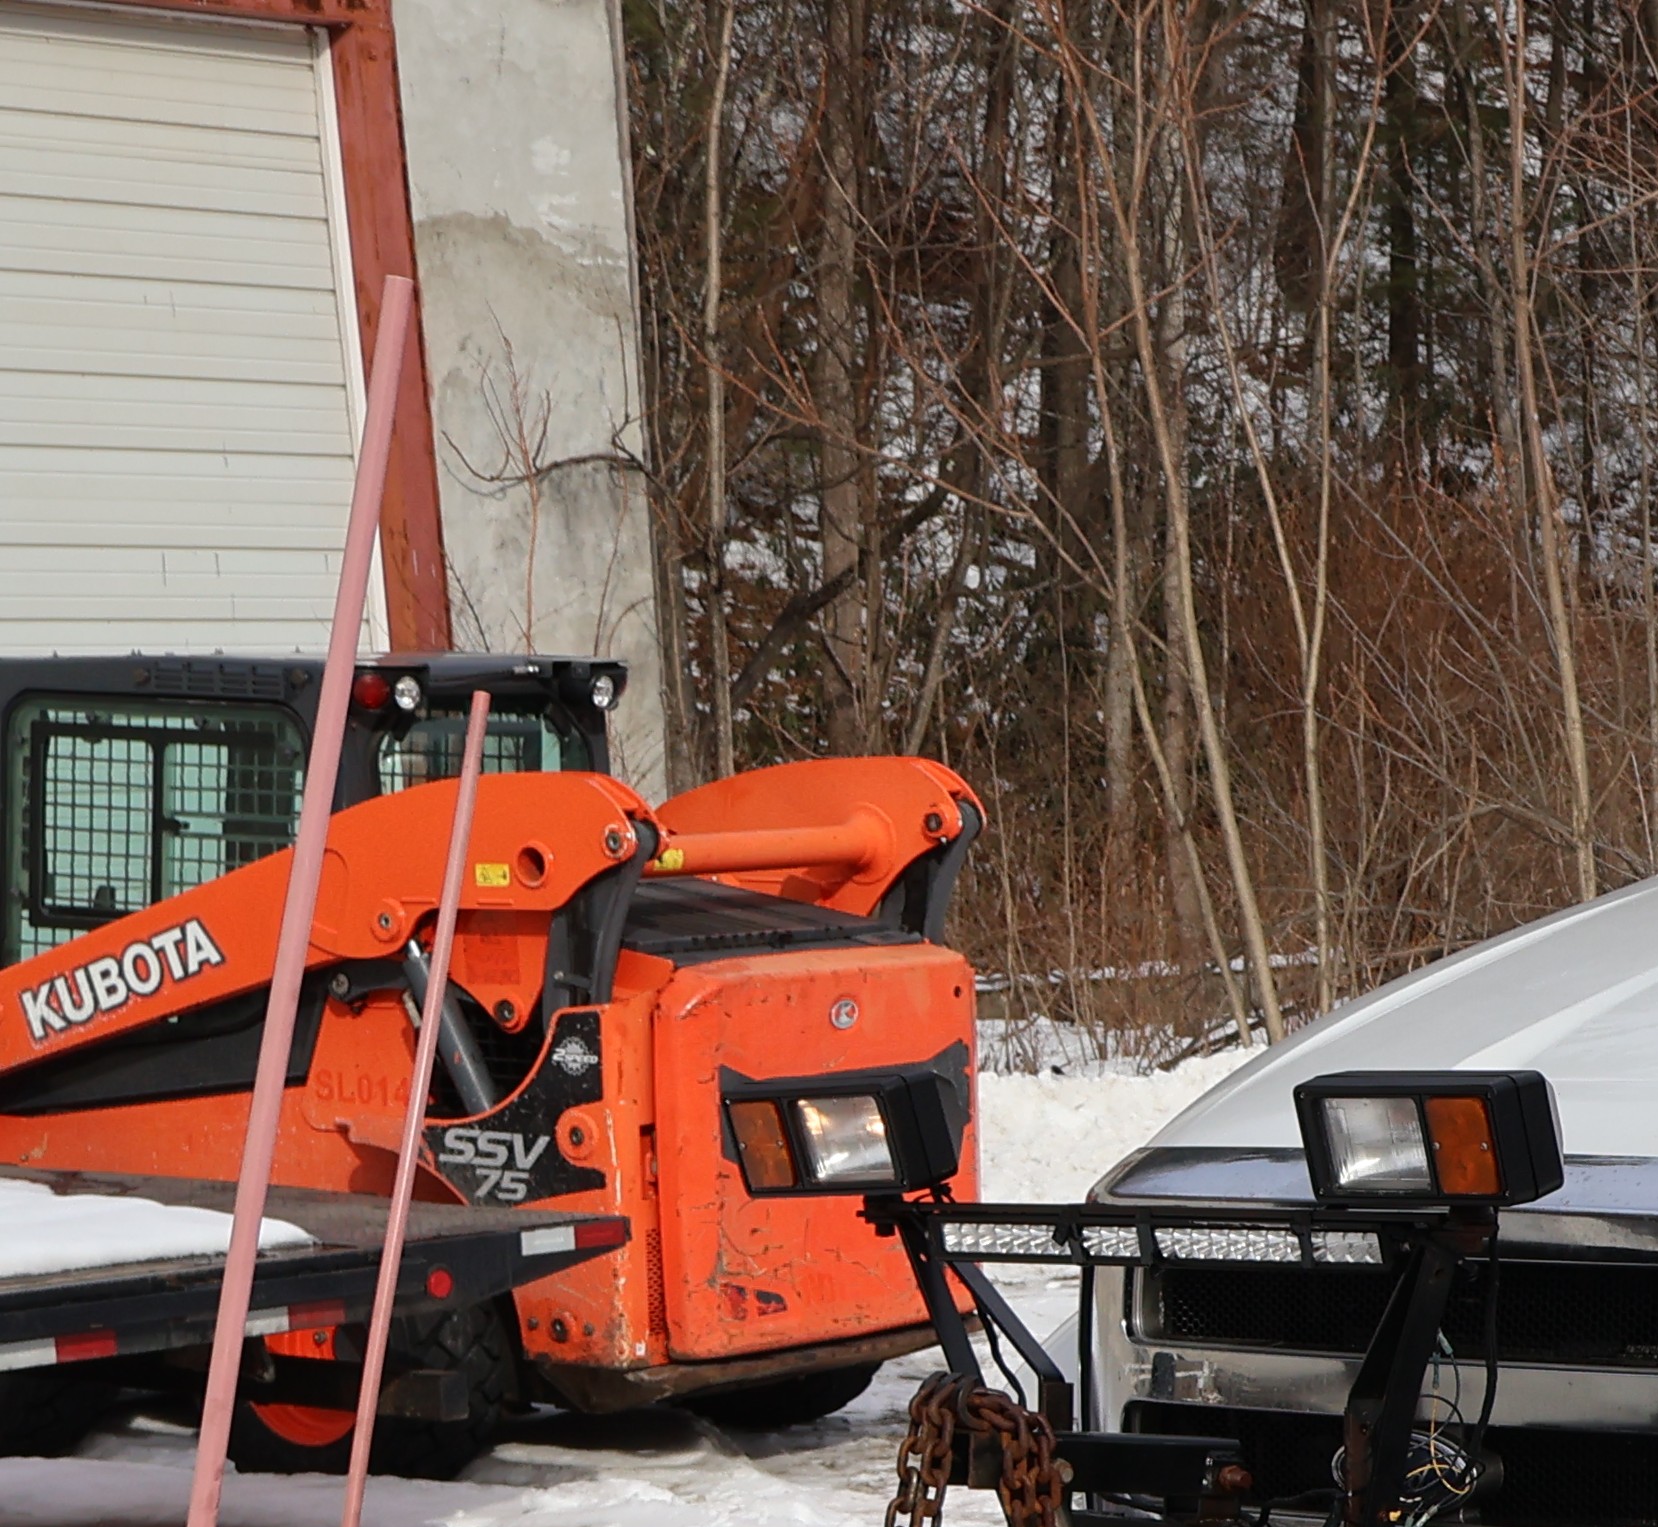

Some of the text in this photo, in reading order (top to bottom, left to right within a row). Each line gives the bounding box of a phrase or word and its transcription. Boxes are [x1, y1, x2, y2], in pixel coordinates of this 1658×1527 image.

[20, 918, 224, 1041] KUBOTA
[438, 1128, 550, 1170] SSV
[474, 1167, 529, 1201] 75
